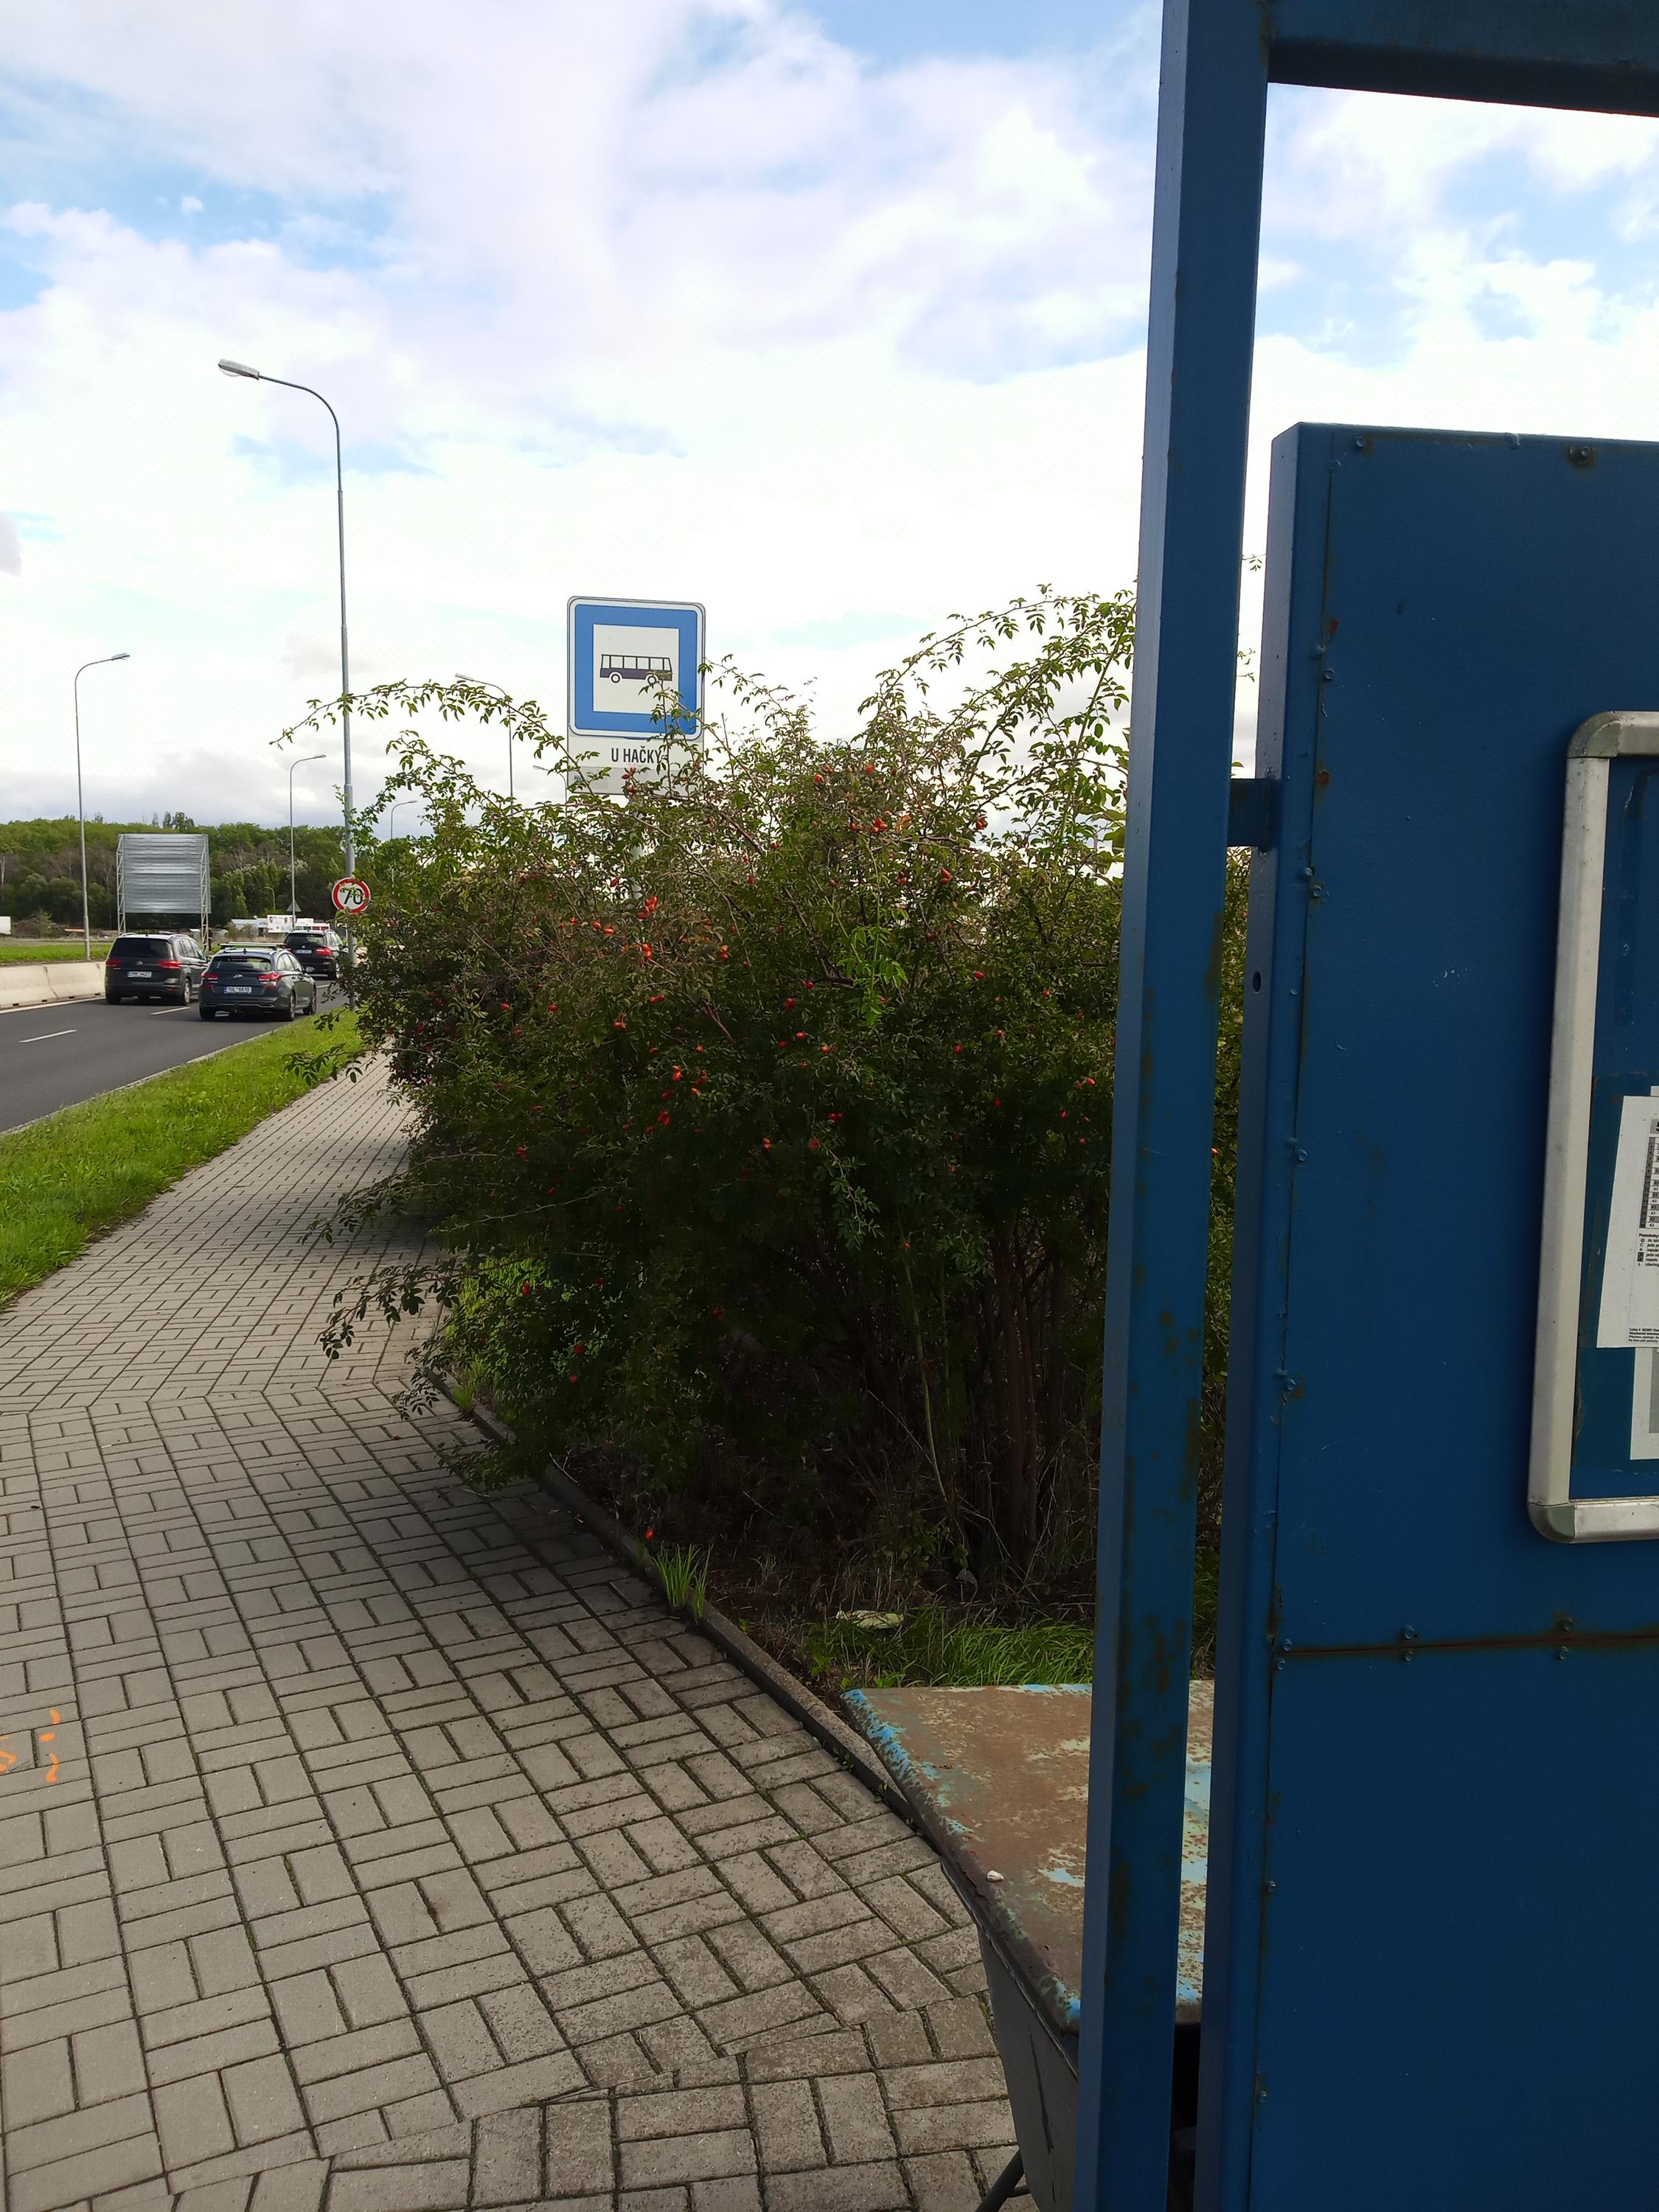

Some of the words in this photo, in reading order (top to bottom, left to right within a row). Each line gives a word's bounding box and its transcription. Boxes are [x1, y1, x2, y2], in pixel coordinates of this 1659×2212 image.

[611, 748, 619, 762] U
[623, 745, 662, 764] HAČKY
[339, 888, 364, 905] 70
